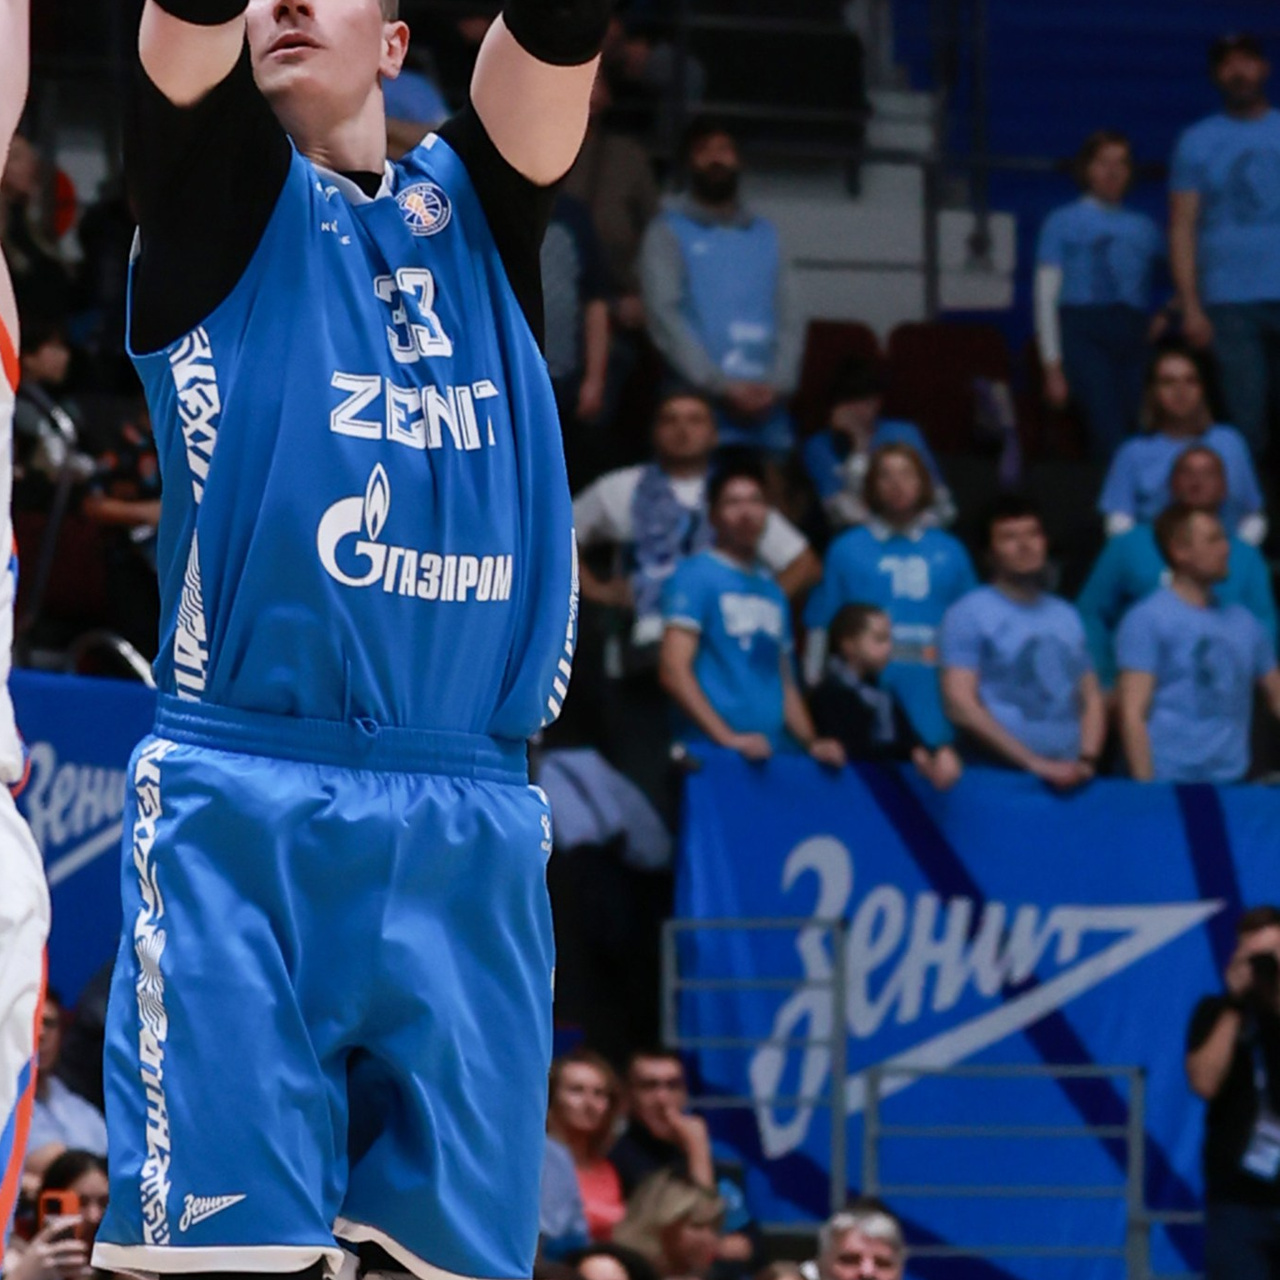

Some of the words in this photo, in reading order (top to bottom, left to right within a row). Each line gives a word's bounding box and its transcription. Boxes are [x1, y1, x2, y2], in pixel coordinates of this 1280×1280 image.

[373, 266, 454, 364] 33
[382, 545, 514, 603] ГАЗПРОМ
[748, 833, 1226, 1160] Зенит
